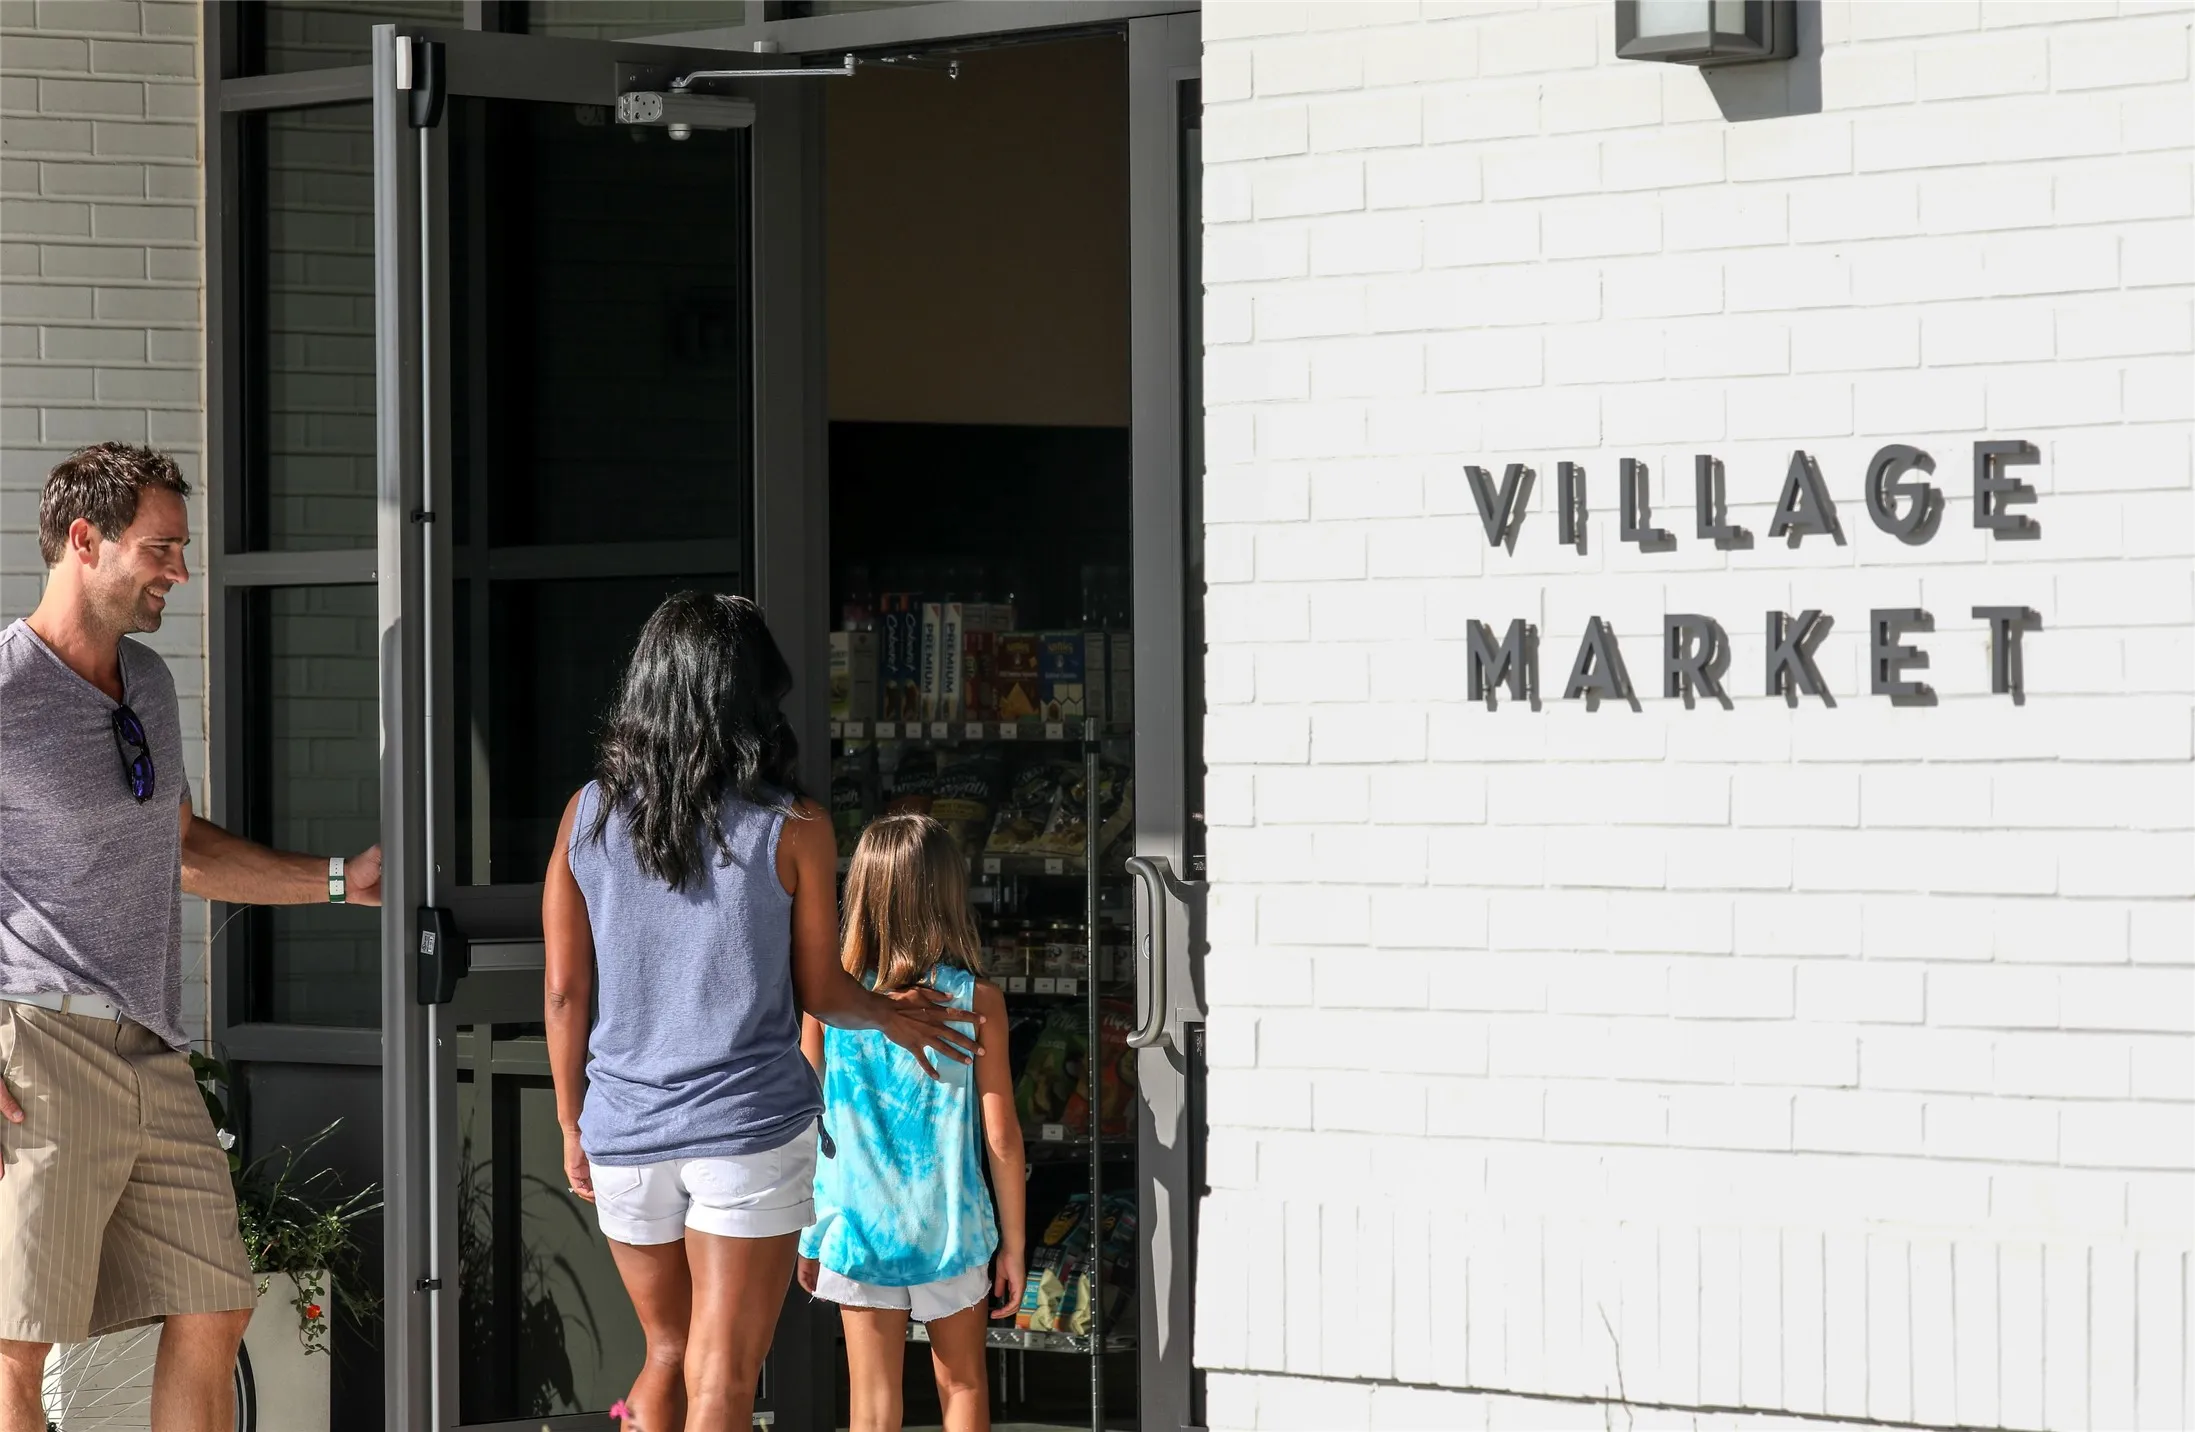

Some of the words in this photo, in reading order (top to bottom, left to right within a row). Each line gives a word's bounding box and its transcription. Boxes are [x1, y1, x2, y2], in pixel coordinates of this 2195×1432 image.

[1463, 439, 2029, 547] VILLAGE
[924, 622, 934, 694] PREMIUM
[945, 622, 956, 694] PREMIUM
[1466, 605, 2031, 702] MARKET
